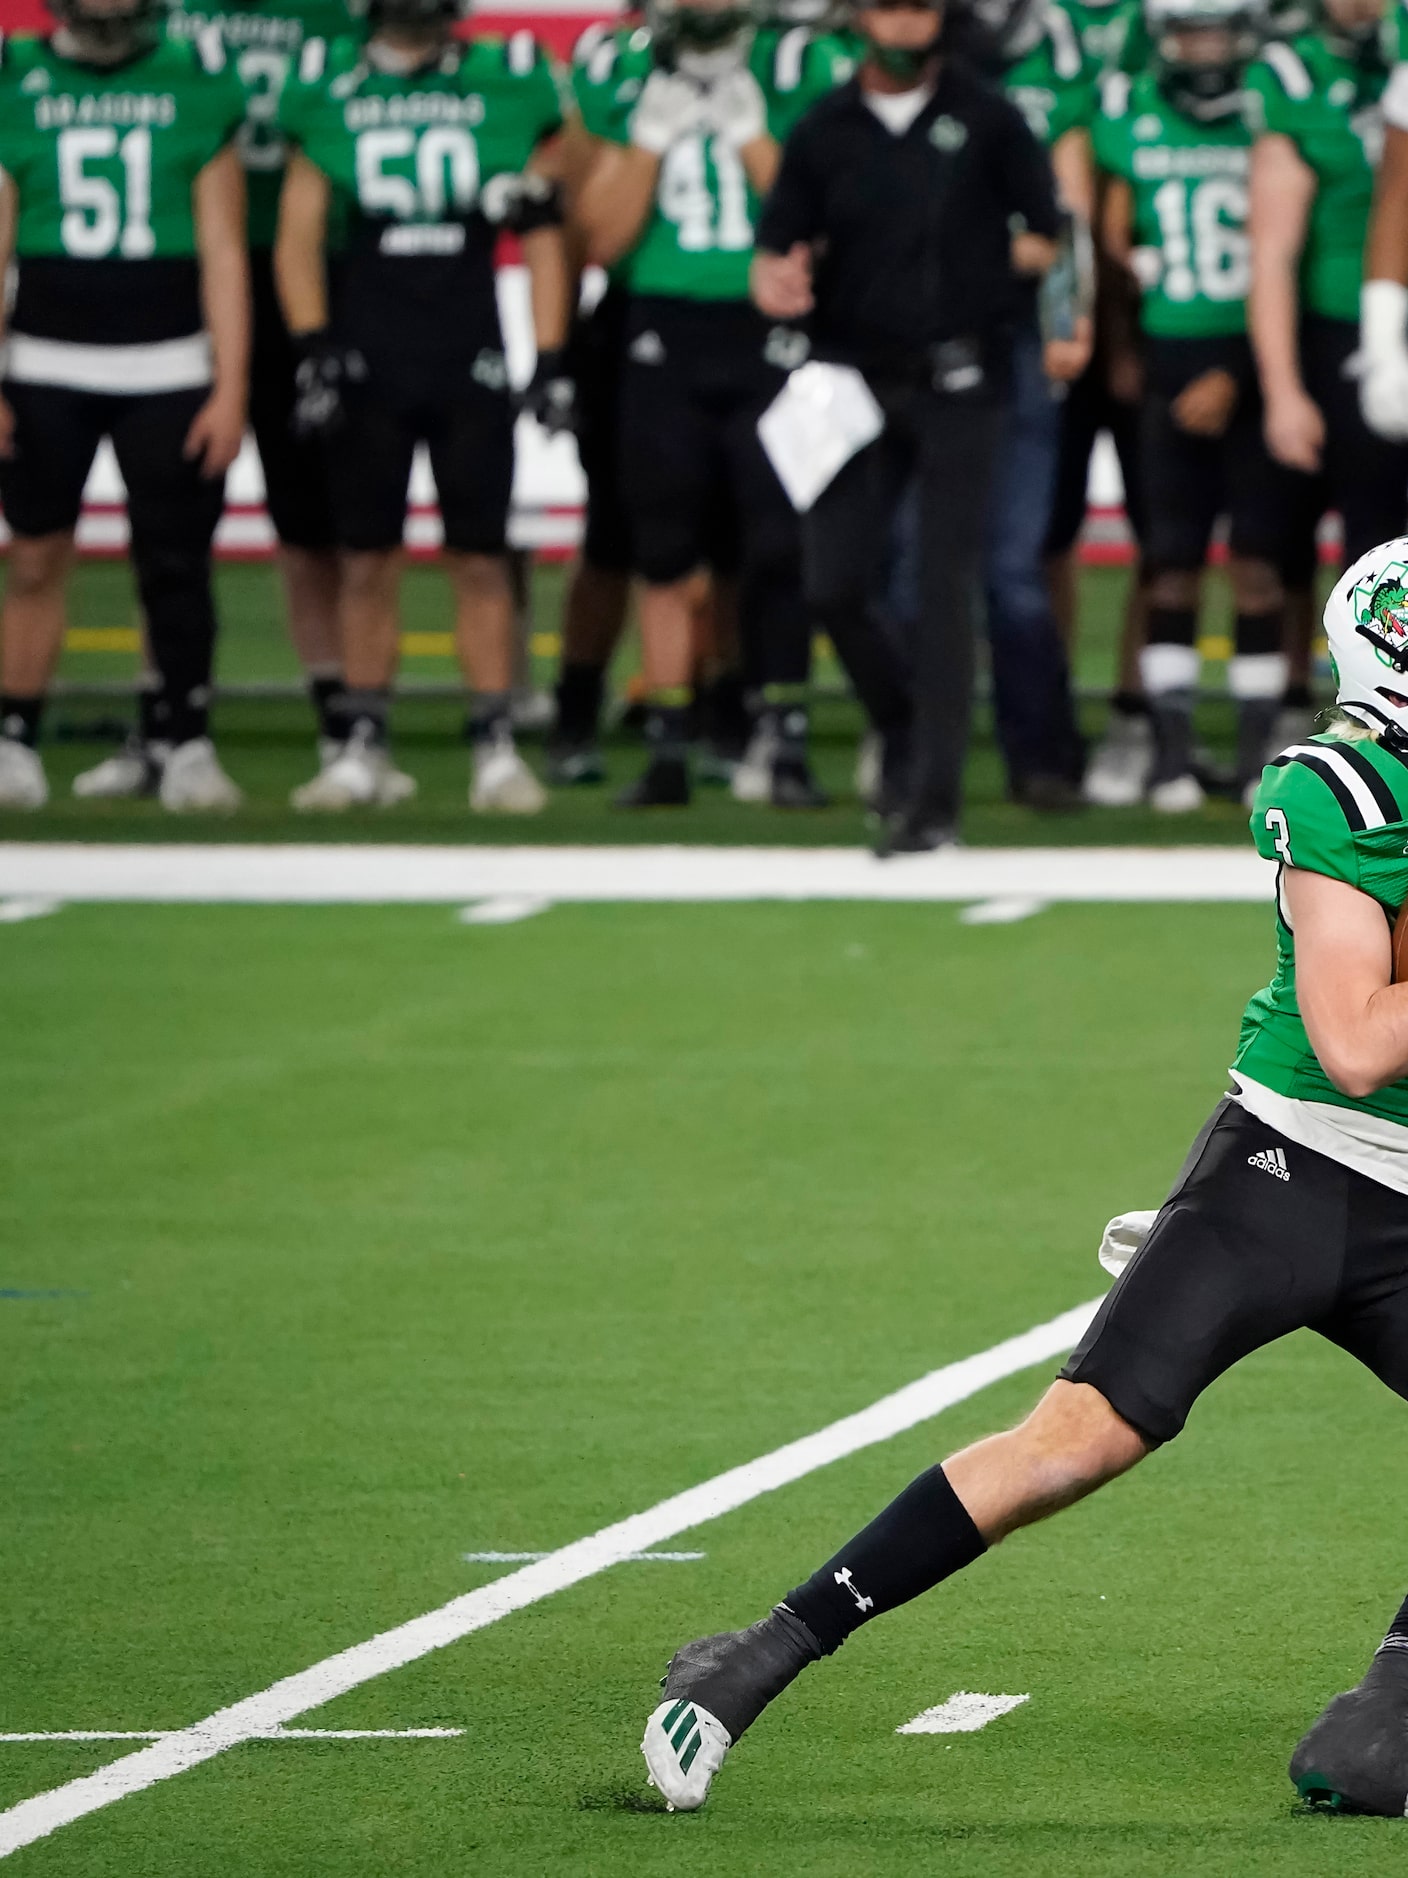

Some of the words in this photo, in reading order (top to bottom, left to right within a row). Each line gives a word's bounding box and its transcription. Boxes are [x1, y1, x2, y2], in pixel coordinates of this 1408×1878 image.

[57, 126, 156, 259] 51
[355, 127, 479, 217] 50
[660, 138, 754, 251] 41
[1154, 178, 1251, 302] 16
[1264, 807, 1295, 868] 3
[1247, 1155, 1291, 1182] adidas
